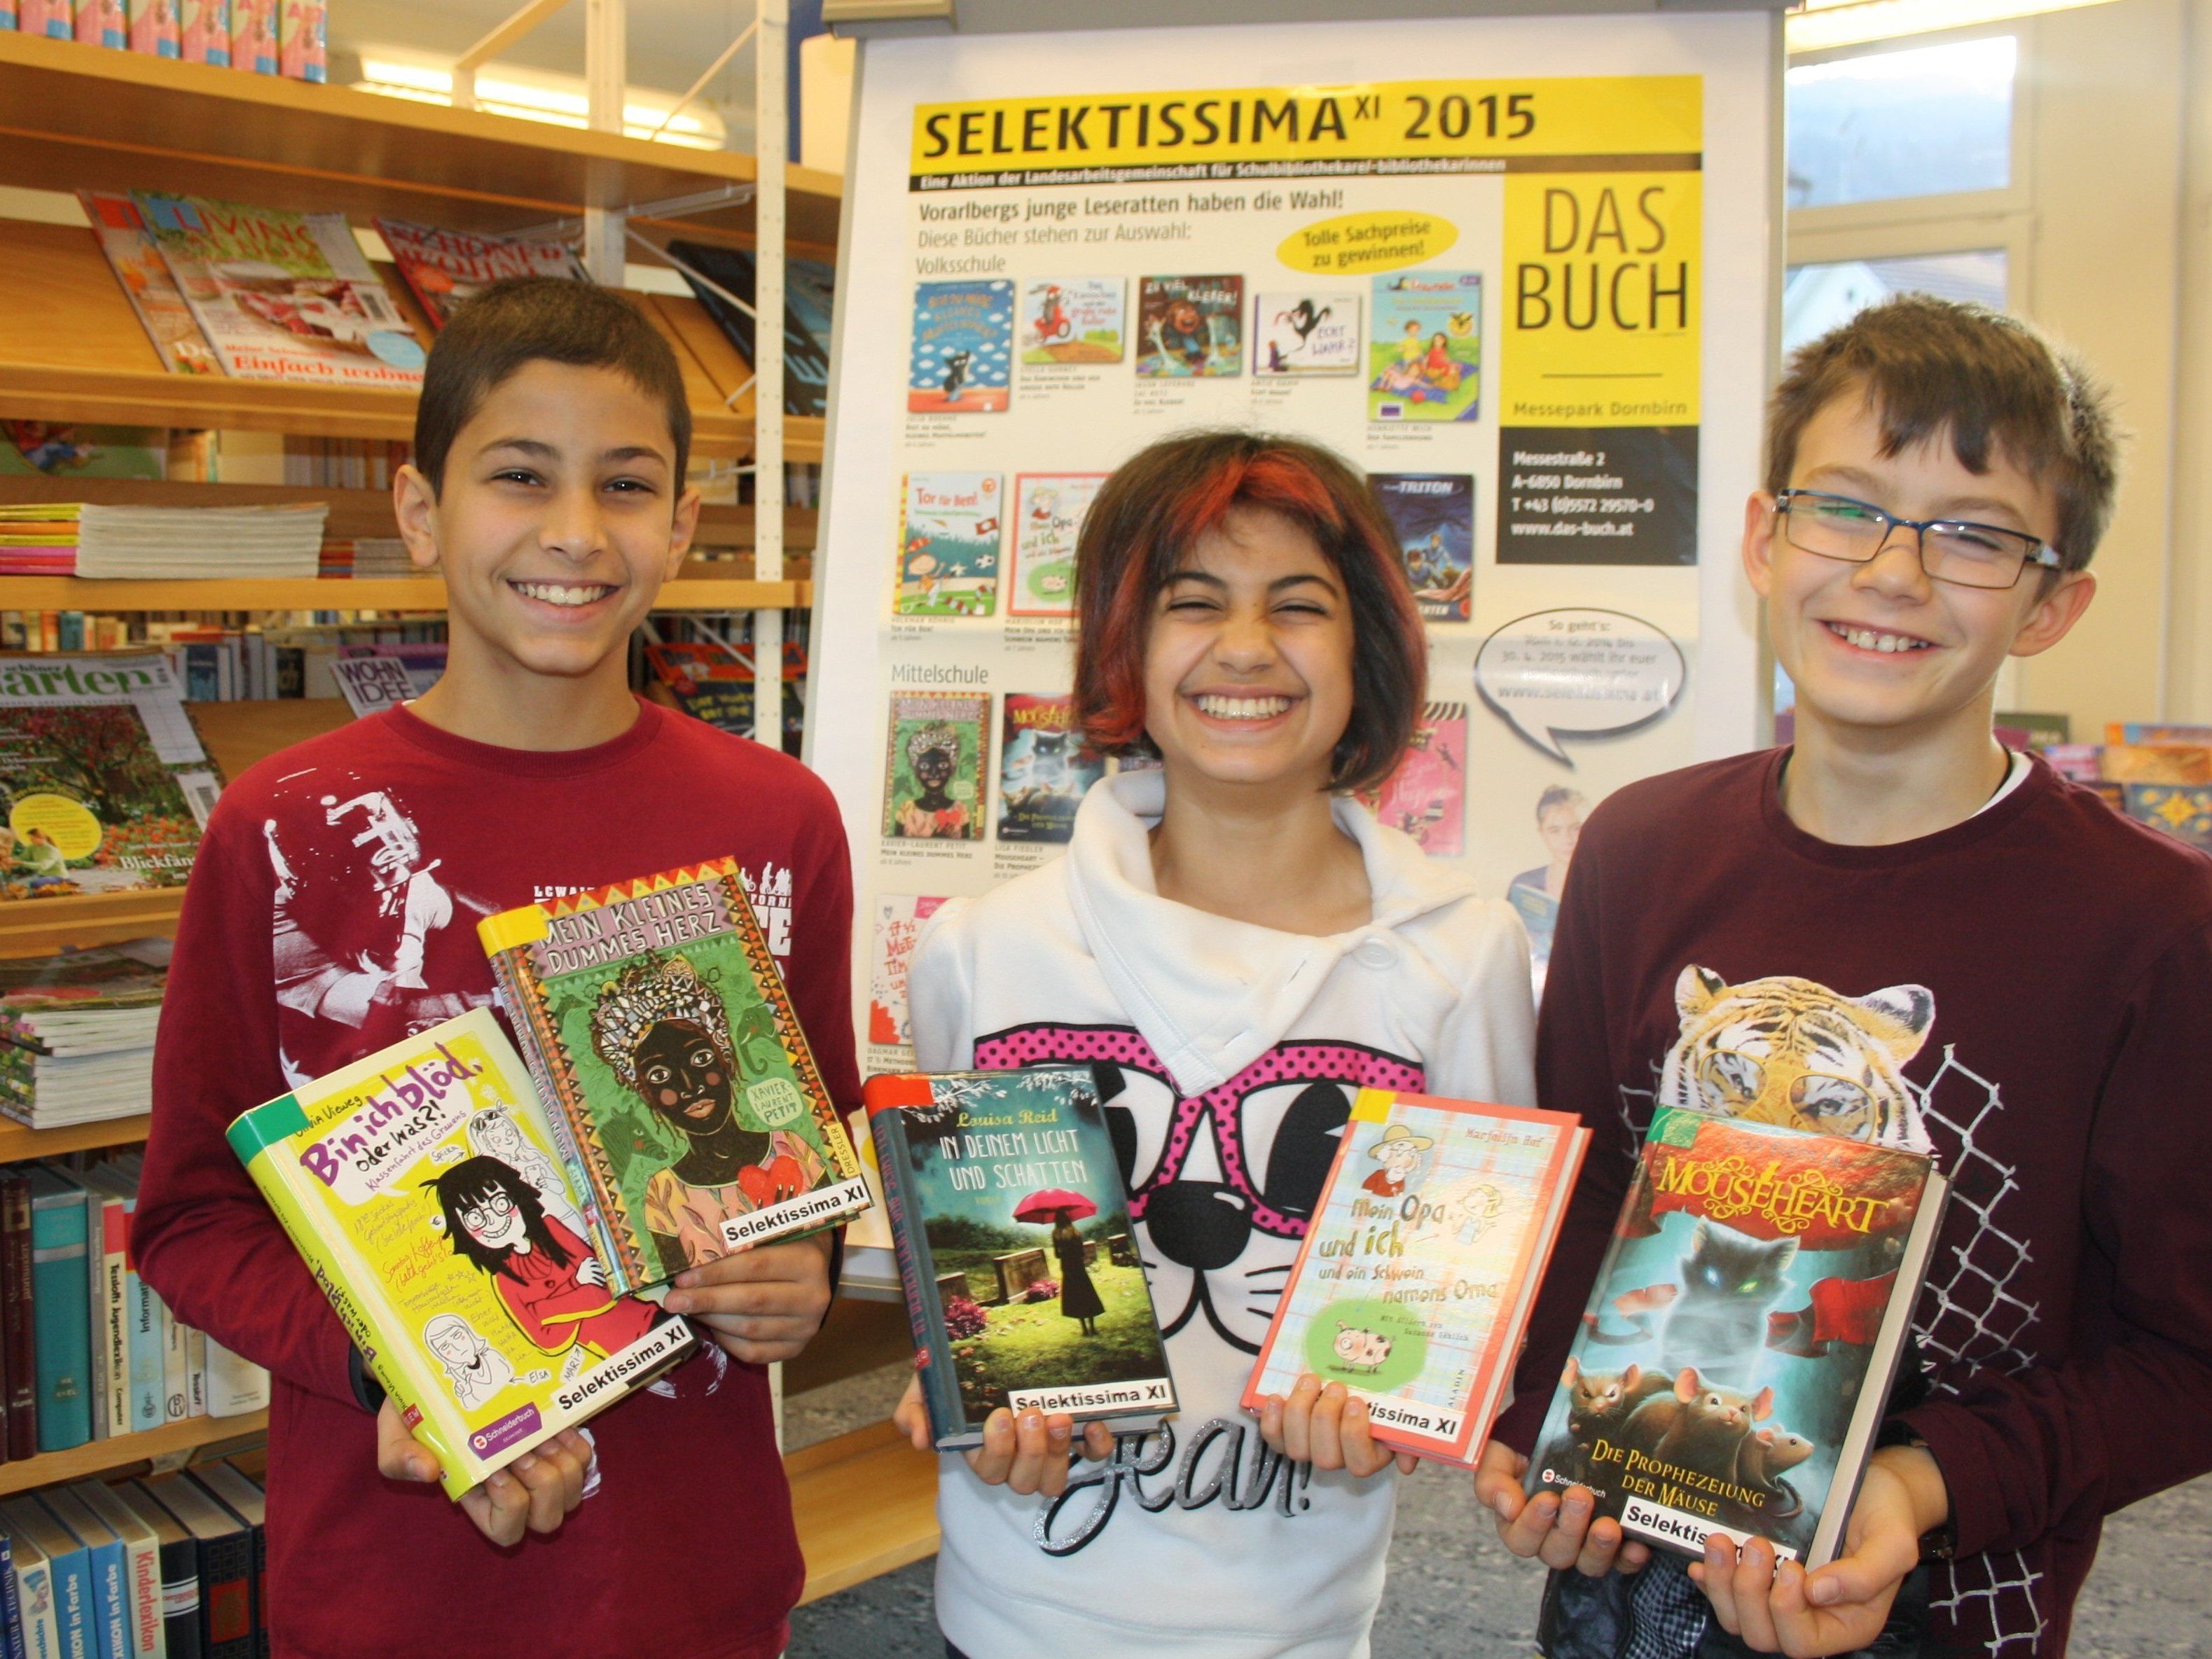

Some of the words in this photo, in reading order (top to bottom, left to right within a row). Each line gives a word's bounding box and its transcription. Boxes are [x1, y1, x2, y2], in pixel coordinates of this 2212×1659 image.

[922, 97, 1348, 158] SELEKTISSIMA
[1404, 93, 1535, 140] 2015
[920, 175, 948, 190] Eine
[951, 172, 995, 188] Aktion
[998, 171, 1021, 186] der
[1024, 164, 1207, 186] Landesarbeitsgemeinschaft
[1210, 162, 1233, 179] für
[919, 202, 1018, 223] Vorarlbergs
[1025, 197, 1077, 223] junge
[1084, 196, 1180, 215] Leseratten
[1187, 193, 1245, 212] haben
[1253, 190, 1282, 210] die
[1290, 189, 1344, 209] Wahl!
[1543, 186, 1666, 255] DAS
[918, 228, 958, 248] Diese
[964, 225, 1018, 247] Bücher
[1024, 225, 1078, 244] stehen
[1084, 228, 1109, 242] zur
[1115, 221, 1191, 241] Auswahl:
[1303, 228, 1341, 248] Tolle
[1346, 218, 1432, 244] Sachpreise
[915, 254, 1006, 274] Volksschule
[1313, 251, 1332, 268] zu
[1337, 240, 1425, 269] gewinnen!
[1516, 260, 1688, 331] BUCH
[233, 356, 333, 377] Einfach
[1514, 401, 1603, 418] Messepark
[1611, 400, 1687, 415] Dornbirn
[1513, 450, 1594, 466] Messestraße
[1596, 452, 1606, 466] 2
[1563, 473, 1624, 490] Dornbirn
[1511, 497, 1522, 512] T
[1511, 521, 1635, 537] www.das-buch.at
[0, 664, 152, 696] arten
[338, 660, 406, 683] WOHN
[891, 663, 989, 684] Mittelschule
[352, 681, 417, 703] IDEE
[538, 911, 602, 951] MEIN
[611, 882, 714, 933] KLEINES
[547, 929, 647, 975] DUMMES
[654, 910, 722, 947] HERZ
[751, 1081, 791, 1101] XAVIER-
[754, 1092, 794, 1112] LAURENT
[322, 1095, 364, 1121] Vieweg
[763, 1102, 799, 1123] PETIT
[956, 1111, 1014, 1129] Louisa
[1018, 1107, 1059, 1125] Reid
[300, 1133, 369, 1187] Bin
[352, 1095, 404, 1137] ich
[365, 1145, 417, 1192] Klassenfahrt
[417, 1137, 433, 1152] des
[430, 1109, 468, 1140] Grauens
[832, 1127, 855, 1174] DRESSLER
[939, 1134, 961, 1160] IN
[964, 1132, 1030, 1159] DEINEM
[1033, 1129, 1079, 1155] LICHT
[356, 1143, 392, 1172] oder
[949, 1165, 987, 1191] UND
[993, 1160, 1088, 1189] SCHATTEN
[1657, 1156, 1890, 1234] MOUSEHEART
[726, 1195, 843, 1242] Selektissima
[843, 1185, 865, 1203] XI
[1350, 1199, 1394, 1219] Mein
[1400, 1194, 1446, 1231] Opa
[1319, 1234, 1355, 1259] und
[1364, 1225, 1404, 1258] ich
[1318, 1265, 1343, 1280] und
[1345, 1265, 1366, 1281] ein
[1371, 1263, 1424, 1281] Schwein
[1382, 1284, 1448, 1304] namens
[1453, 1279, 1497, 1301] Oma
[110, 1307, 122, 1380] Jugendlexikon
[558, 1340, 666, 1411] Selektissima
[663, 1324, 687, 1345] XI
[1015, 1386, 1141, 1413] Selektissima
[1146, 1384, 1167, 1401] XI
[1447, 1368, 1465, 1408] ALADIN
[485, 1408, 535, 1443] Schneiderbuch
[1367, 1401, 1439, 1430] issima
[1435, 1414, 1458, 1436] XI
[66, 1573, 79, 1606] Farbe
[104, 1563, 118, 1601] Farbe
[135, 1550, 159, 1652] Kinderlexikon
